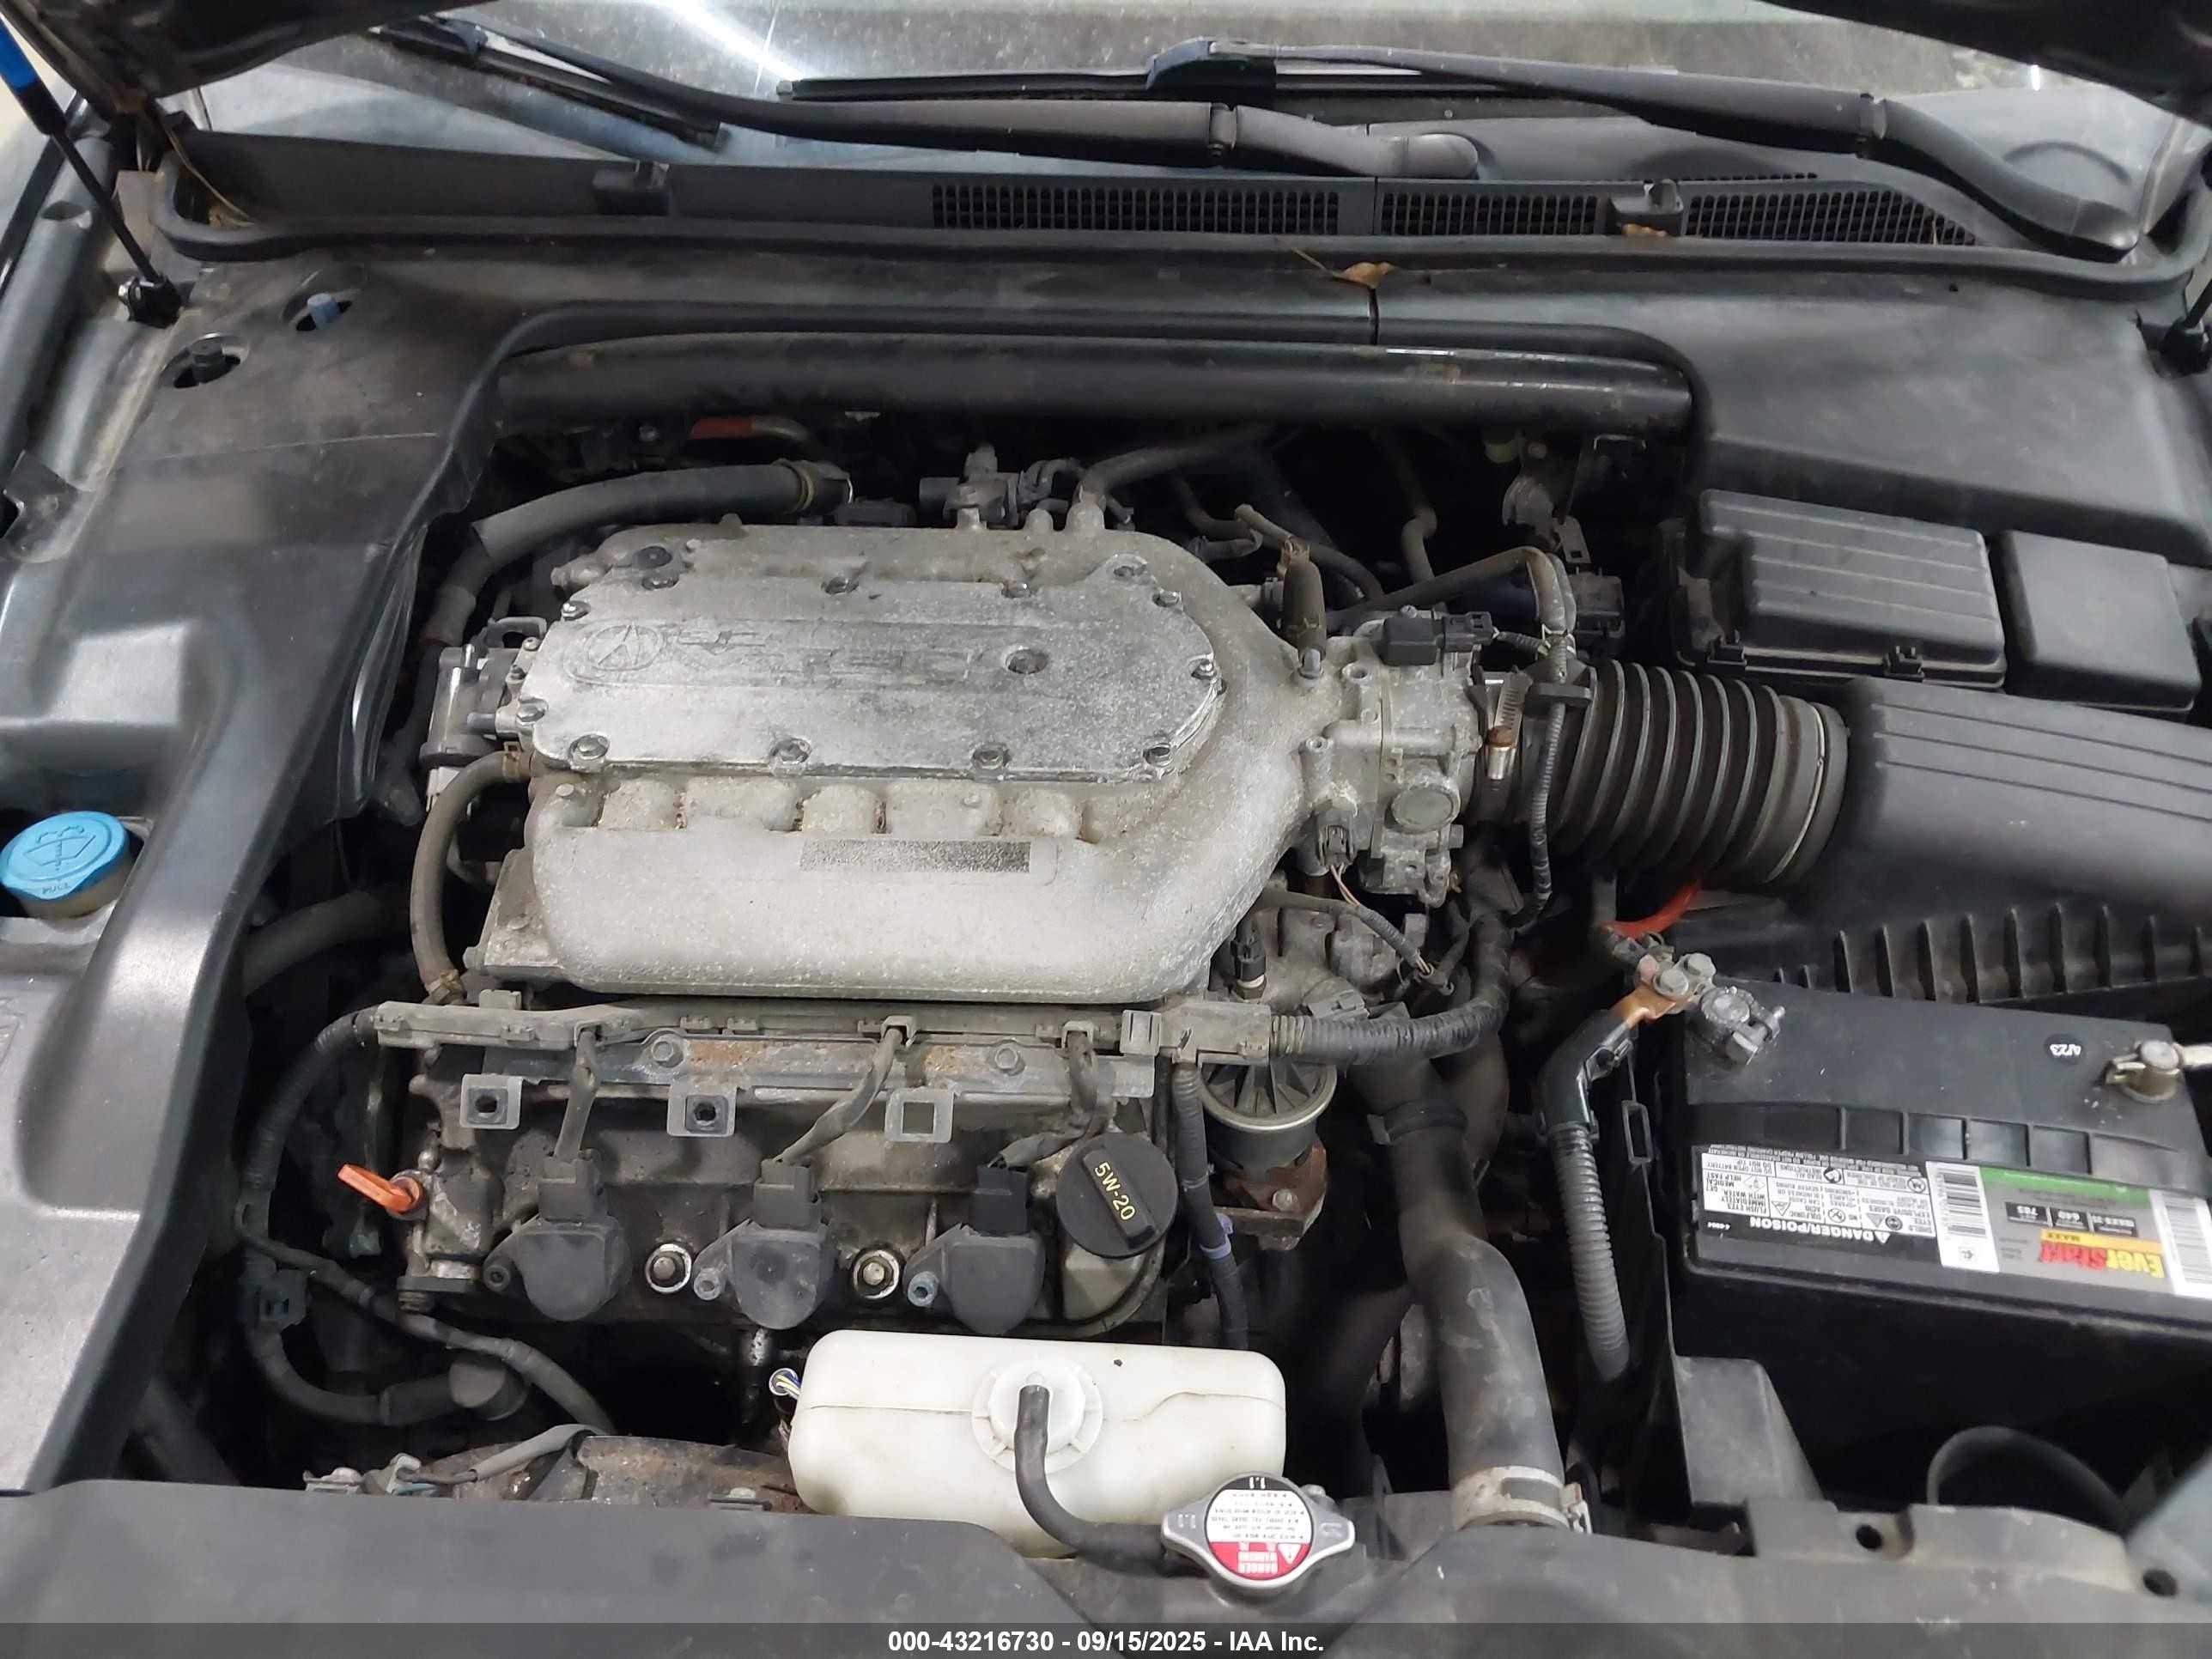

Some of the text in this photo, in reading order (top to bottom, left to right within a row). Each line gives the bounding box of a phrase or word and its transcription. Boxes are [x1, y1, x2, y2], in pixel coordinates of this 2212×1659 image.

[1095, 1162, 1135, 1220] 5W-20
[1749, 1216, 1875, 1242] DANGER/POISON
[2040, 1241, 2165, 1279] EverStart
[1249, 1476, 1267, 1490] 1.1
